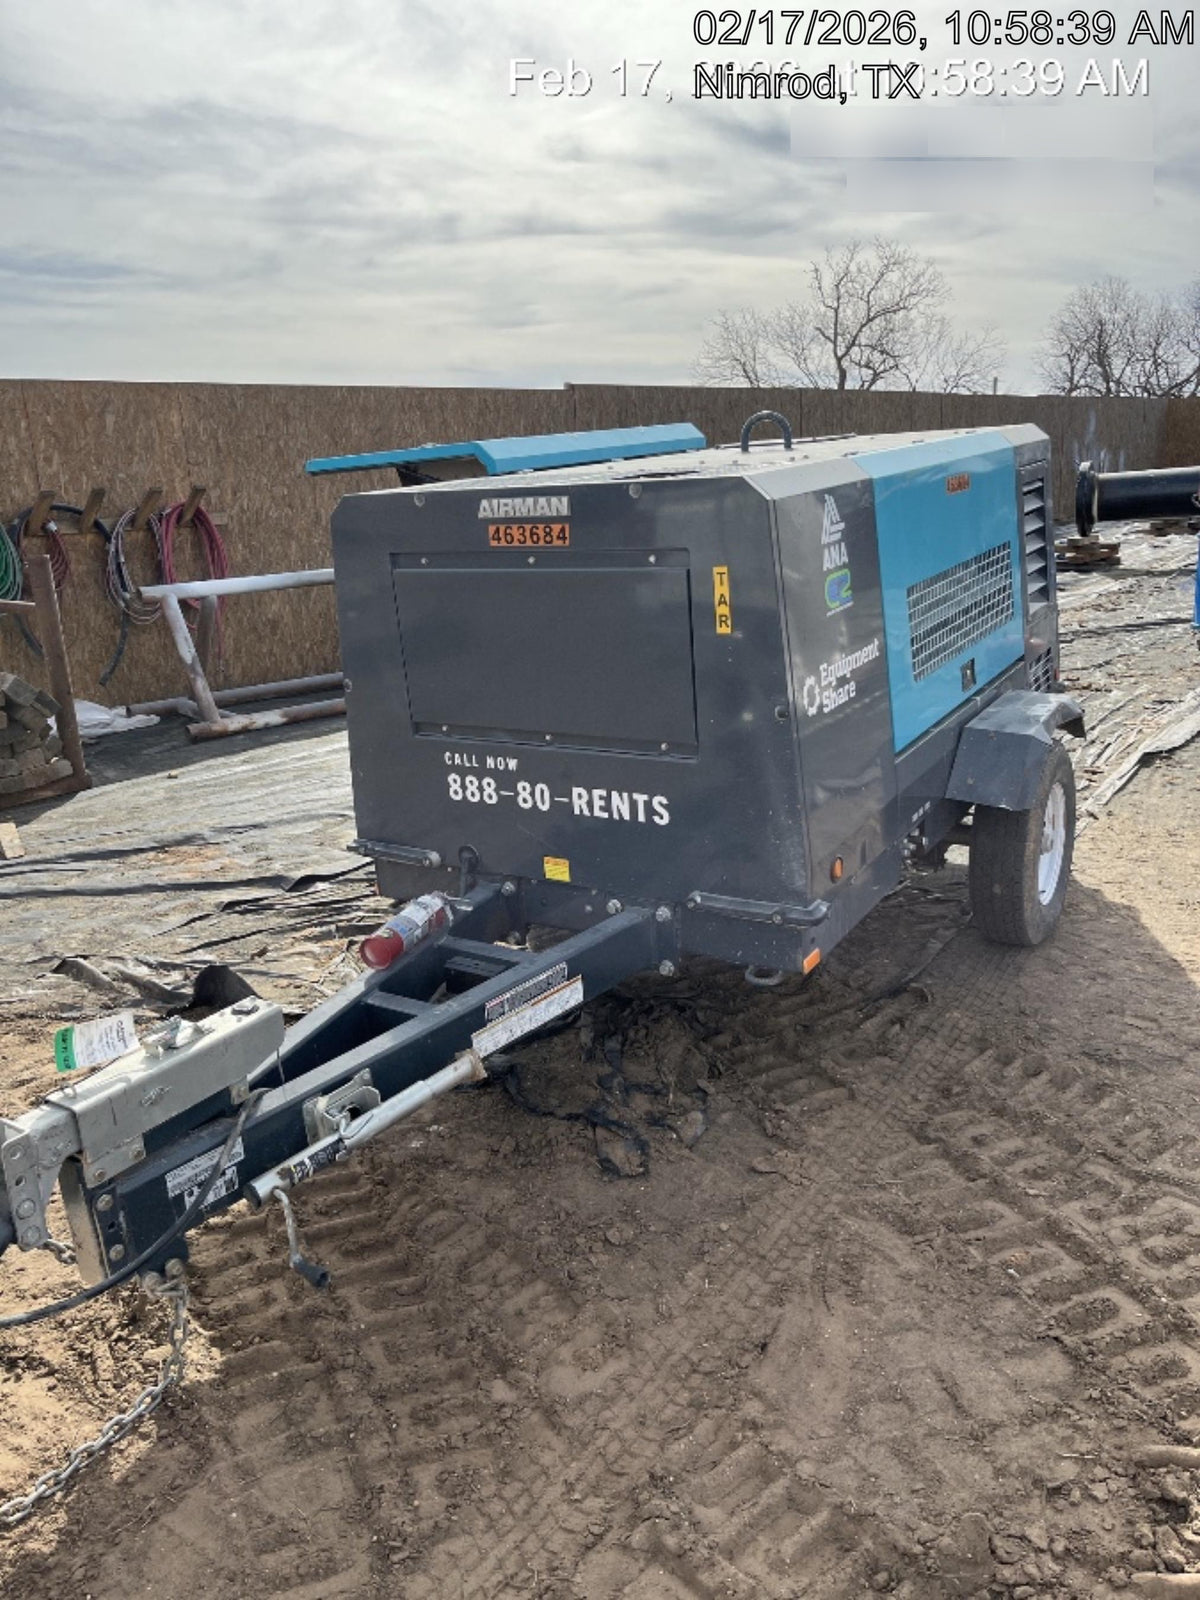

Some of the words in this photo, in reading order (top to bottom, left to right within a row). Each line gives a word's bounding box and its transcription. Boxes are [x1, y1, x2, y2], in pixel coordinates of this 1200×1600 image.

[478, 496, 571, 518] AIRMAN
[491, 525, 568, 545] 463684
[823, 542, 848, 571] ANA
[820, 638, 879, 687] Equipment
[823, 680, 856, 713] Share
[444, 751, 479, 767] CALL
[486, 755, 518, 772] NOW
[447, 773, 670, 826] 888-80-RENTS
